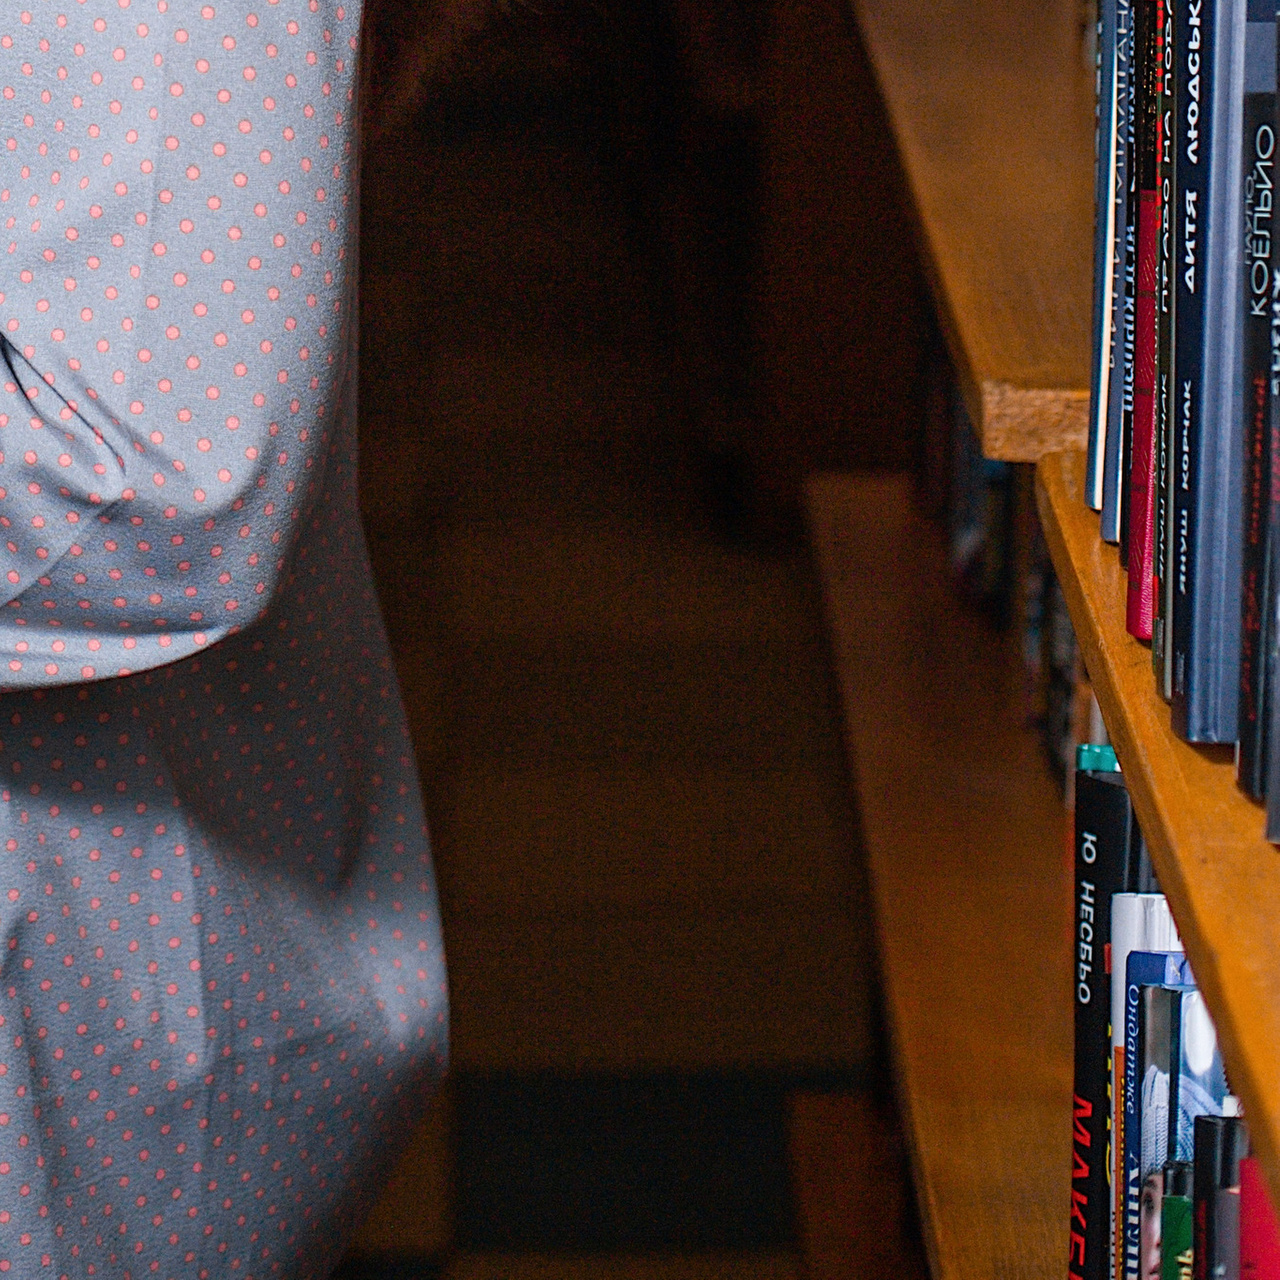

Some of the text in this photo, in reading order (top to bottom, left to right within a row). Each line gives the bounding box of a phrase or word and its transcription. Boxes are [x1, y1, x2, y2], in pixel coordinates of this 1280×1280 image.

[1163, 110, 1172, 163] НА
[1160, 178, 1171, 314] ПРАВО
[1184, 189, 1197, 294] ДИТЯ
[1249, 124, 1275, 316] КОЕЛЬЙО
[1158, 498, 1166, 583] ЯНУШ
[1179, 380, 1192, 595] ЯНУШ КОРЧАК
[1078, 831, 1098, 1005] Ю НЕСБЬО
[1127, 983, 1140, 1115] Ондатже
